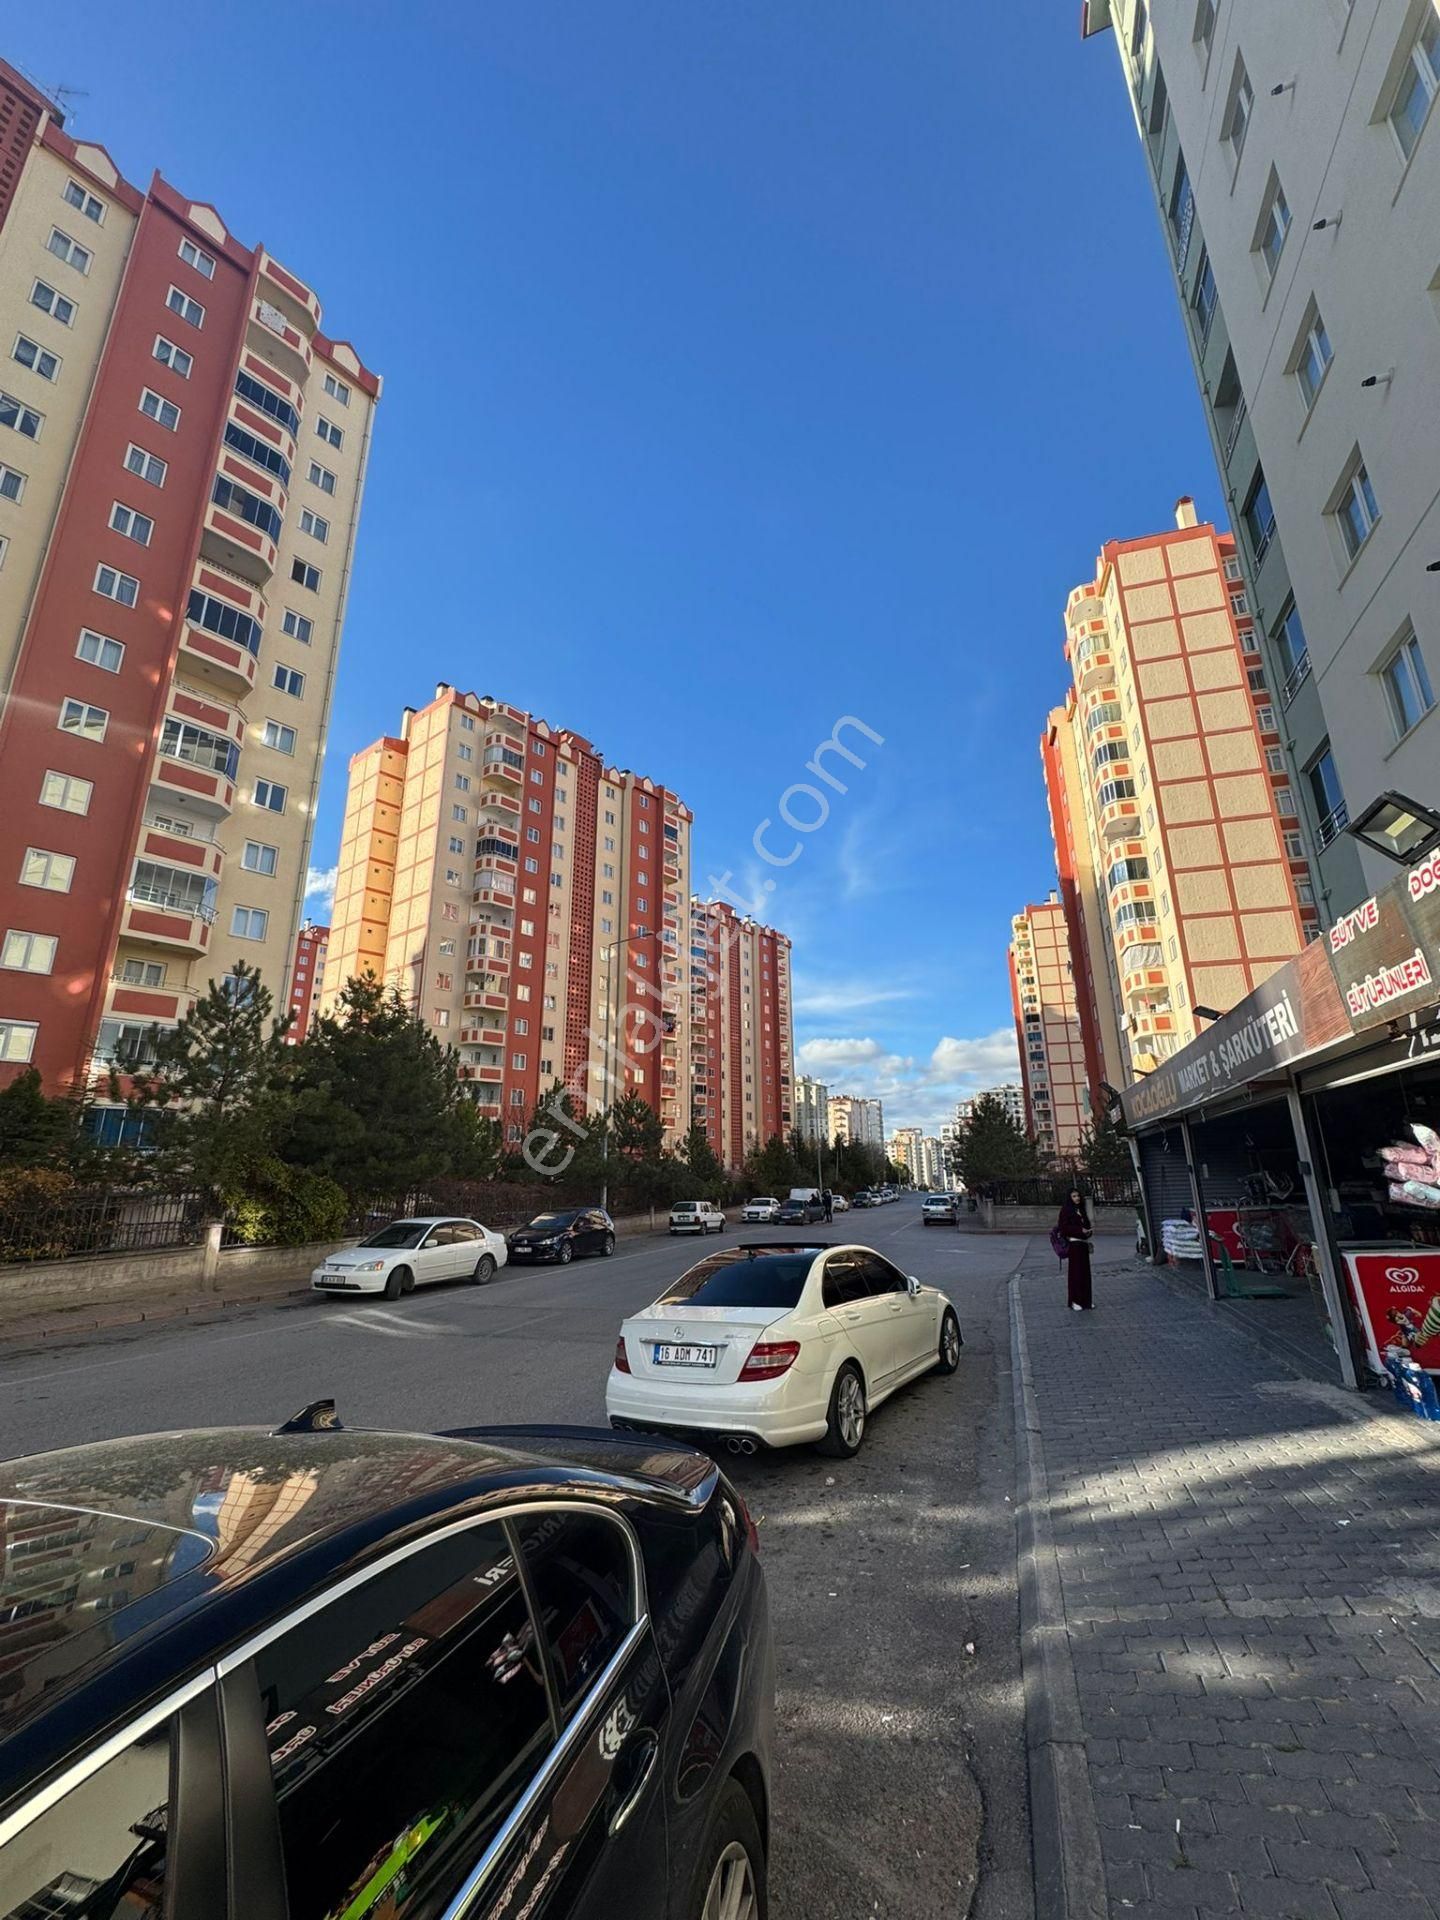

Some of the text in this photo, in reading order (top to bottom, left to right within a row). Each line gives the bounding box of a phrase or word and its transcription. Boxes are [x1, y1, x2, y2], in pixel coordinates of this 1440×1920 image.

[1353, 897, 1378, 932] VE
[1178, 1055, 1210, 1093] MARKET
[1210, 1050, 1221, 1077] &
[1218, 989, 1299, 1079] ŞARKÜTERİ
[660, 1346, 713, 1362] 16 ADM 741
